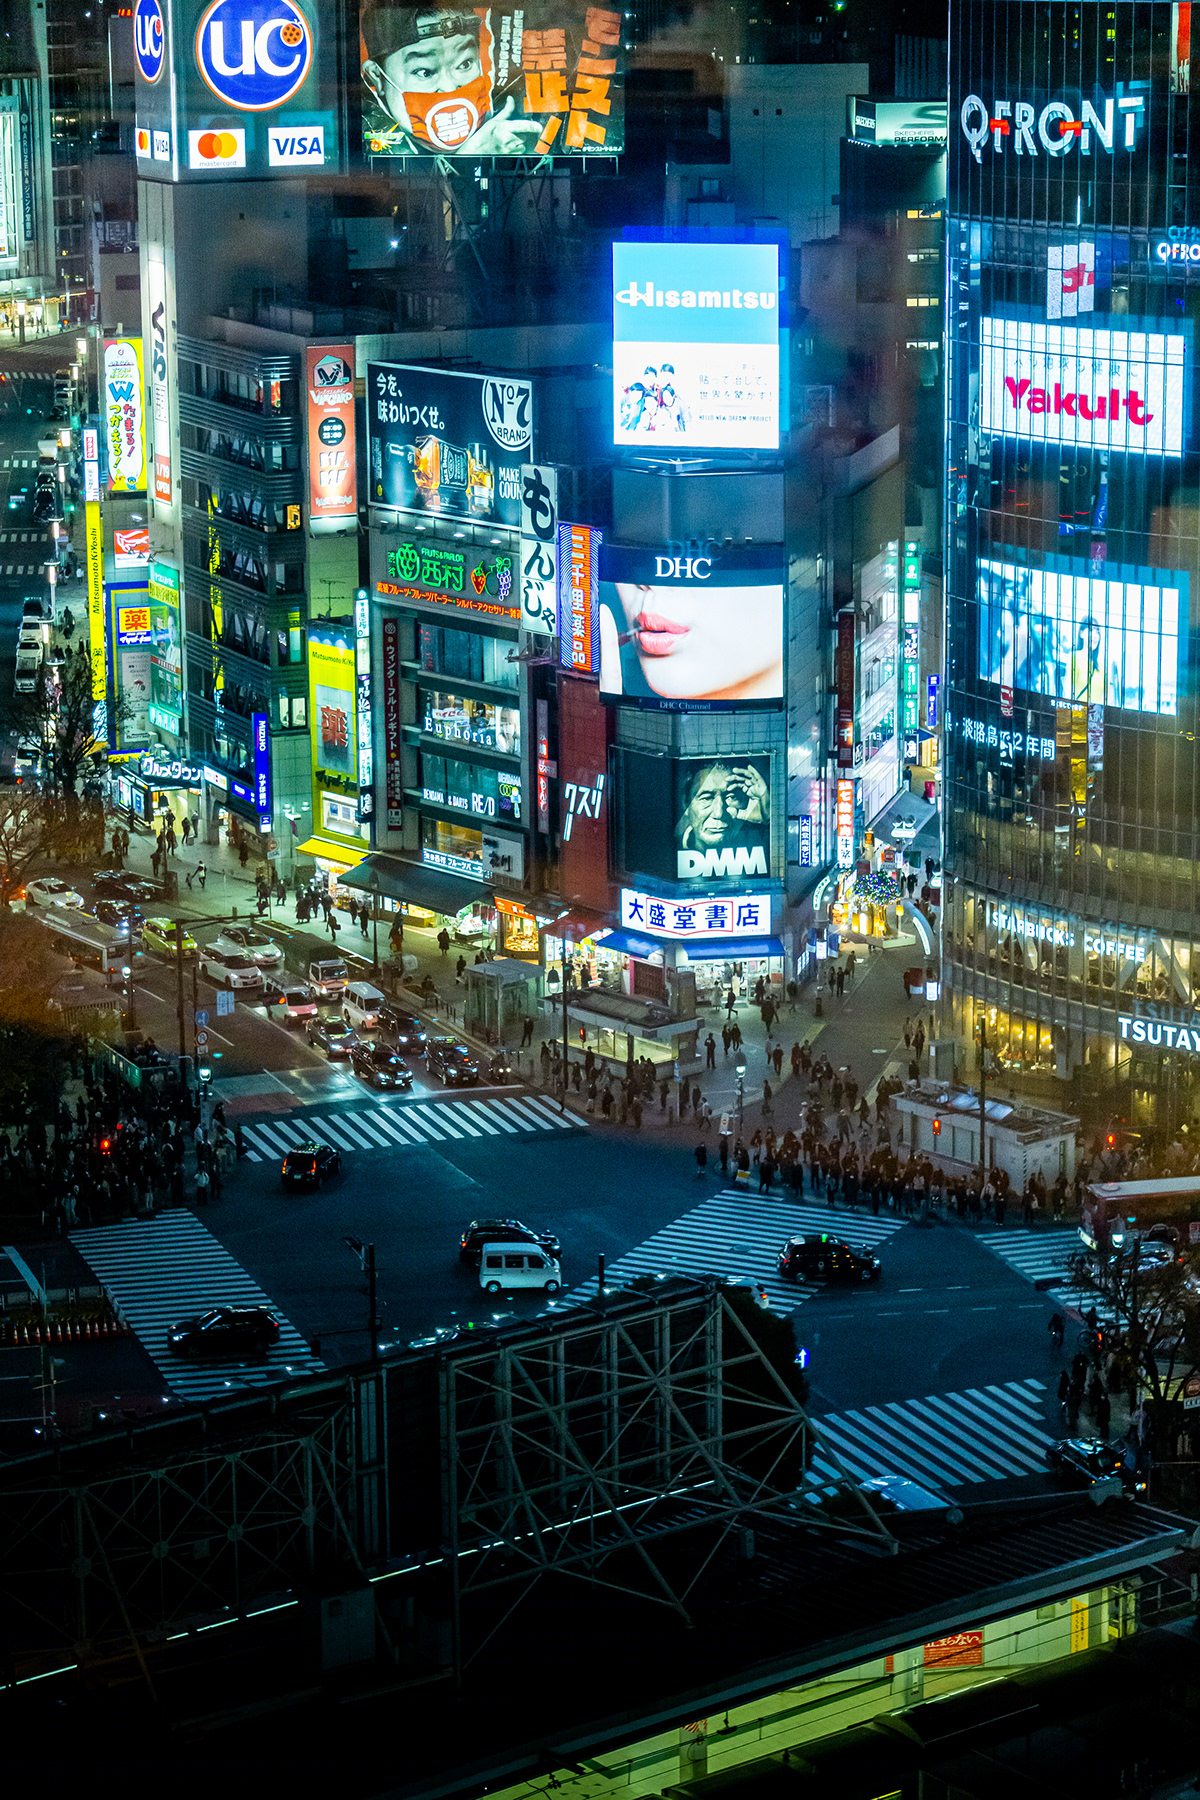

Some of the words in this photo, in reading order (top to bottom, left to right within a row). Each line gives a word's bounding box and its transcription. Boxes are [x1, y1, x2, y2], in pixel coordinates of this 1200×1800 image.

[210, 19, 302, 77] UC
[961, 94, 1144, 163] QFRONT
[271, 137, 322, 156] VISA
[615, 281, 776, 309] Hisamitsu
[108, 382, 134, 402] W
[376, 372, 403, 397] 今を、
[1004, 376, 1154, 426] Yakult
[377, 400, 445, 430] 味わいつくせ。
[497, 426, 528, 442] BRAND
[499, 466, 520, 483] MAKE
[156, 483, 171, 496] OPEN
[422, 559, 464, 592] 西村
[655, 557, 712, 579] DHC
[125, 609, 148, 630] 薬
[312, 651, 341, 664] Matsumoto
[386, 645, 398, 750] ウィンターフルーツギフト
[659, 701, 678, 710] DHC
[678, 701, 711, 710] Channel
[424, 716, 493, 746] Euphoria
[142, 756, 201, 781] グルメタウン
[472, 793, 495, 816] RE/D
[677, 846, 768, 879] DMM
[628, 898, 760, 930] 大盛堂書店
[992, 911, 1075, 947] STARBUCKS
[1084, 935, 1146, 962] COFFEE
